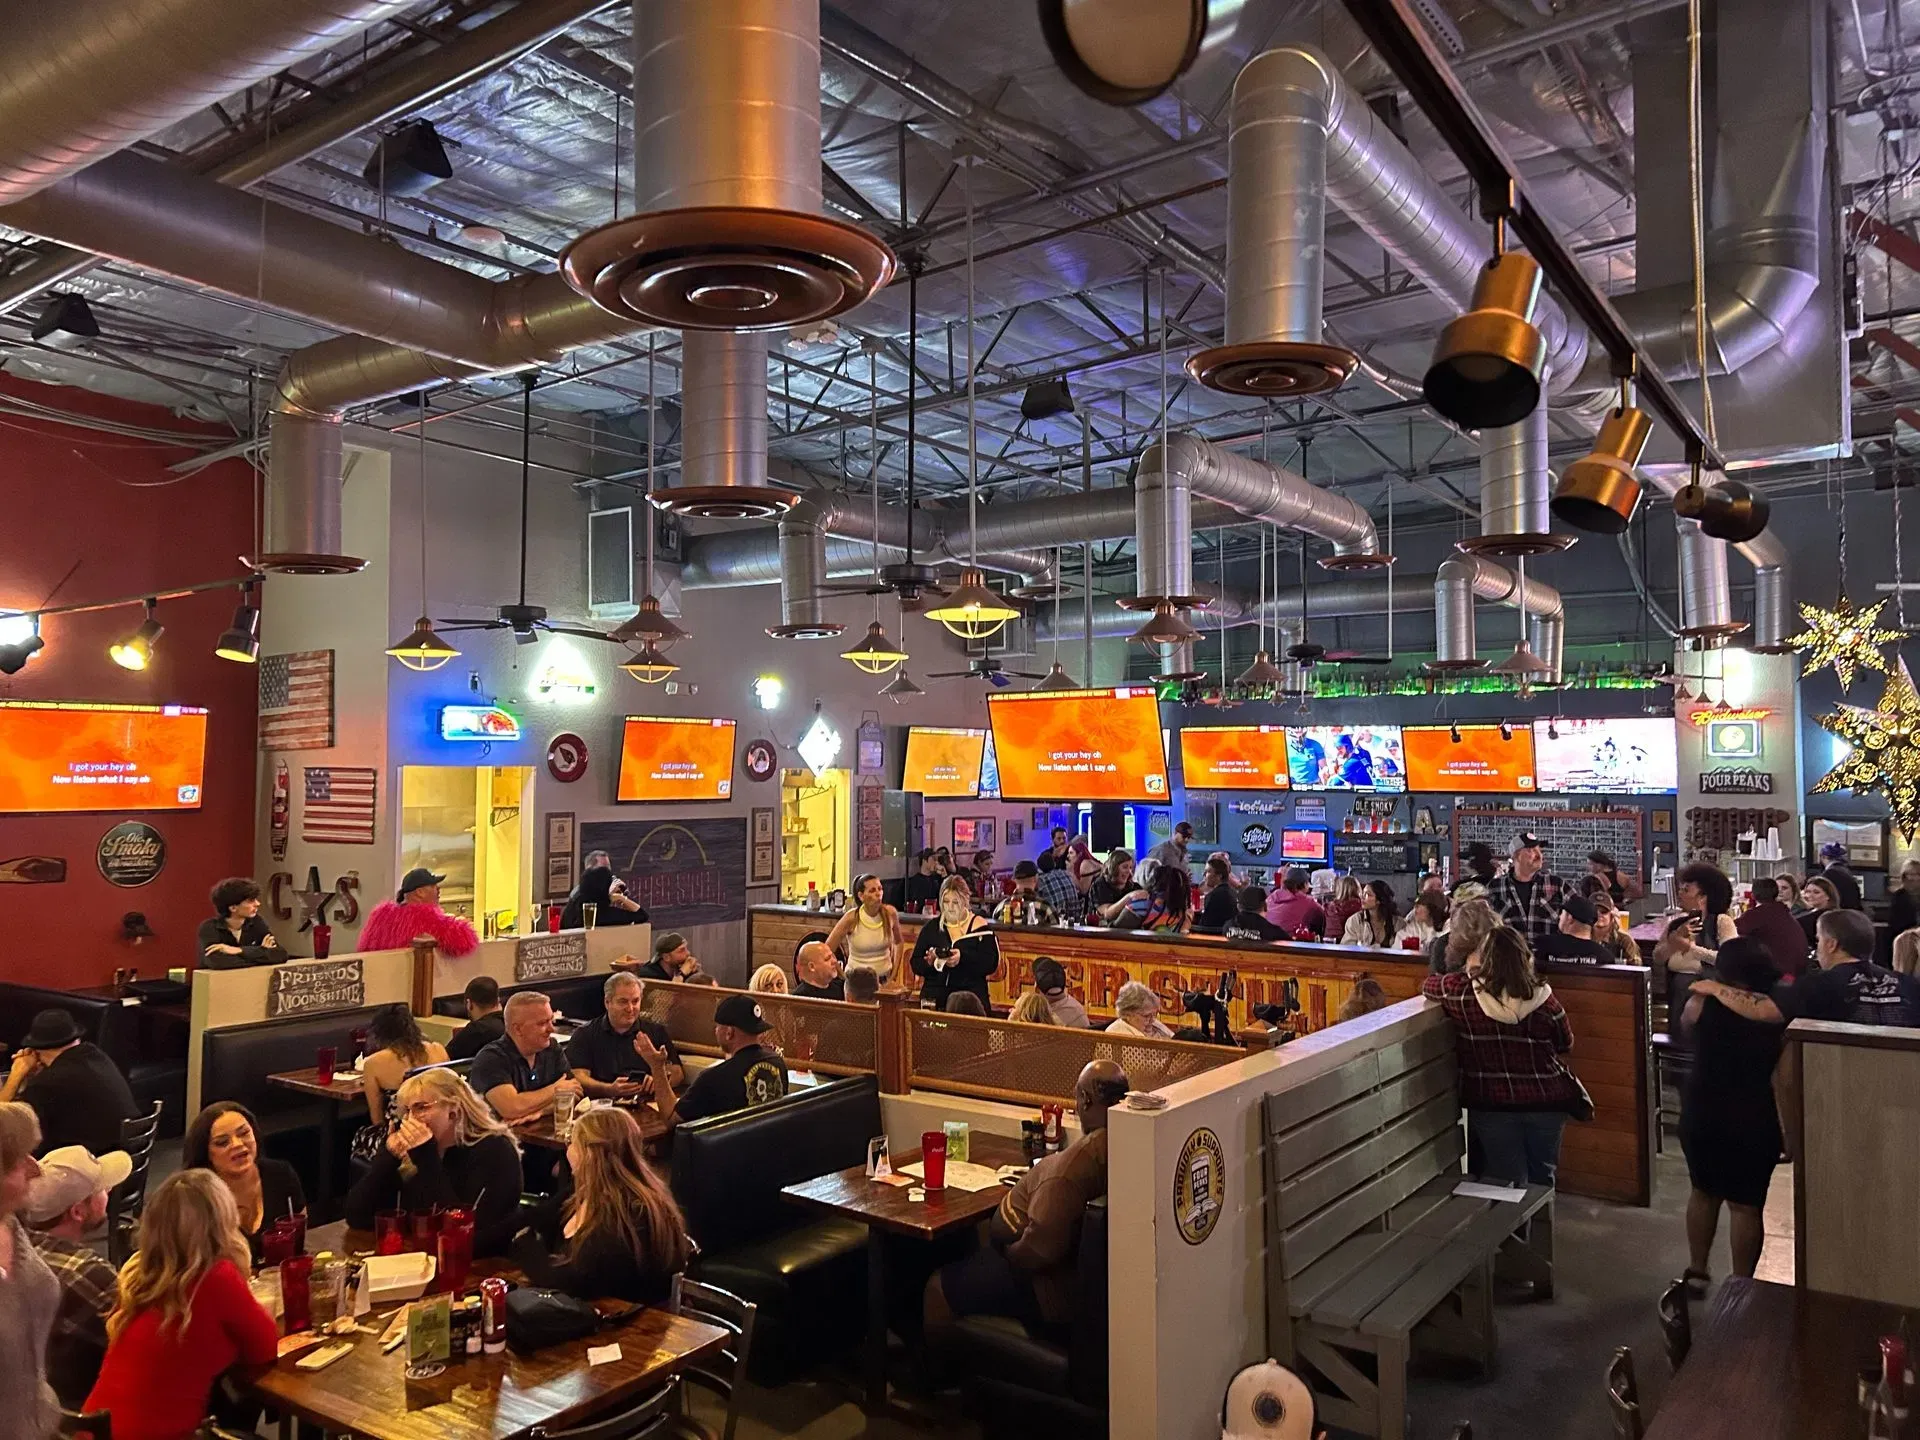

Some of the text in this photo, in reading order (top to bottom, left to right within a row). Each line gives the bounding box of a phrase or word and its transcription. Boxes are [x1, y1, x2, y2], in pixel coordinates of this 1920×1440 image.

[1690, 709, 1771, 726] Budweiser
[1052, 751, 1063, 760] got
[1064, 751, 1078, 760] your
[1079, 751, 1092, 760] hey
[1093, 751, 1102, 759] oh
[75, 763, 89, 772] got
[90, 763, 108, 772] your
[110, 763, 124, 772] hey
[126, 763, 137, 771] oh
[1038, 763, 1052, 771] Now
[1053, 763, 1072, 771] listen
[1072, 763, 1089, 771] what
[1094, 763, 1105, 773] say
[1107, 763, 1117, 771] oh
[98, 775, 118, 783] what
[124, 775, 138, 784] say
[139, 775, 150, 783] oh
[1702, 774, 1770, 792] FOUR PEAKS
[1355, 800, 1393, 812] OLE SMOKY
[126, 832, 145, 843] Ole
[101, 836, 161, 858] Smoky
[526, 943, 580, 959] SUNSHINE
[278, 961, 360, 990] FRIENDS
[520, 955, 584, 980] MOONSHINE
[276, 983, 360, 1015] MOONSHINE
[1177, 1133, 1224, 1209] PROUDLY SUPPORTS
[1192, 1166, 1208, 1182] FOUR
[1193, 1177, 1208, 1190] PEAKS
